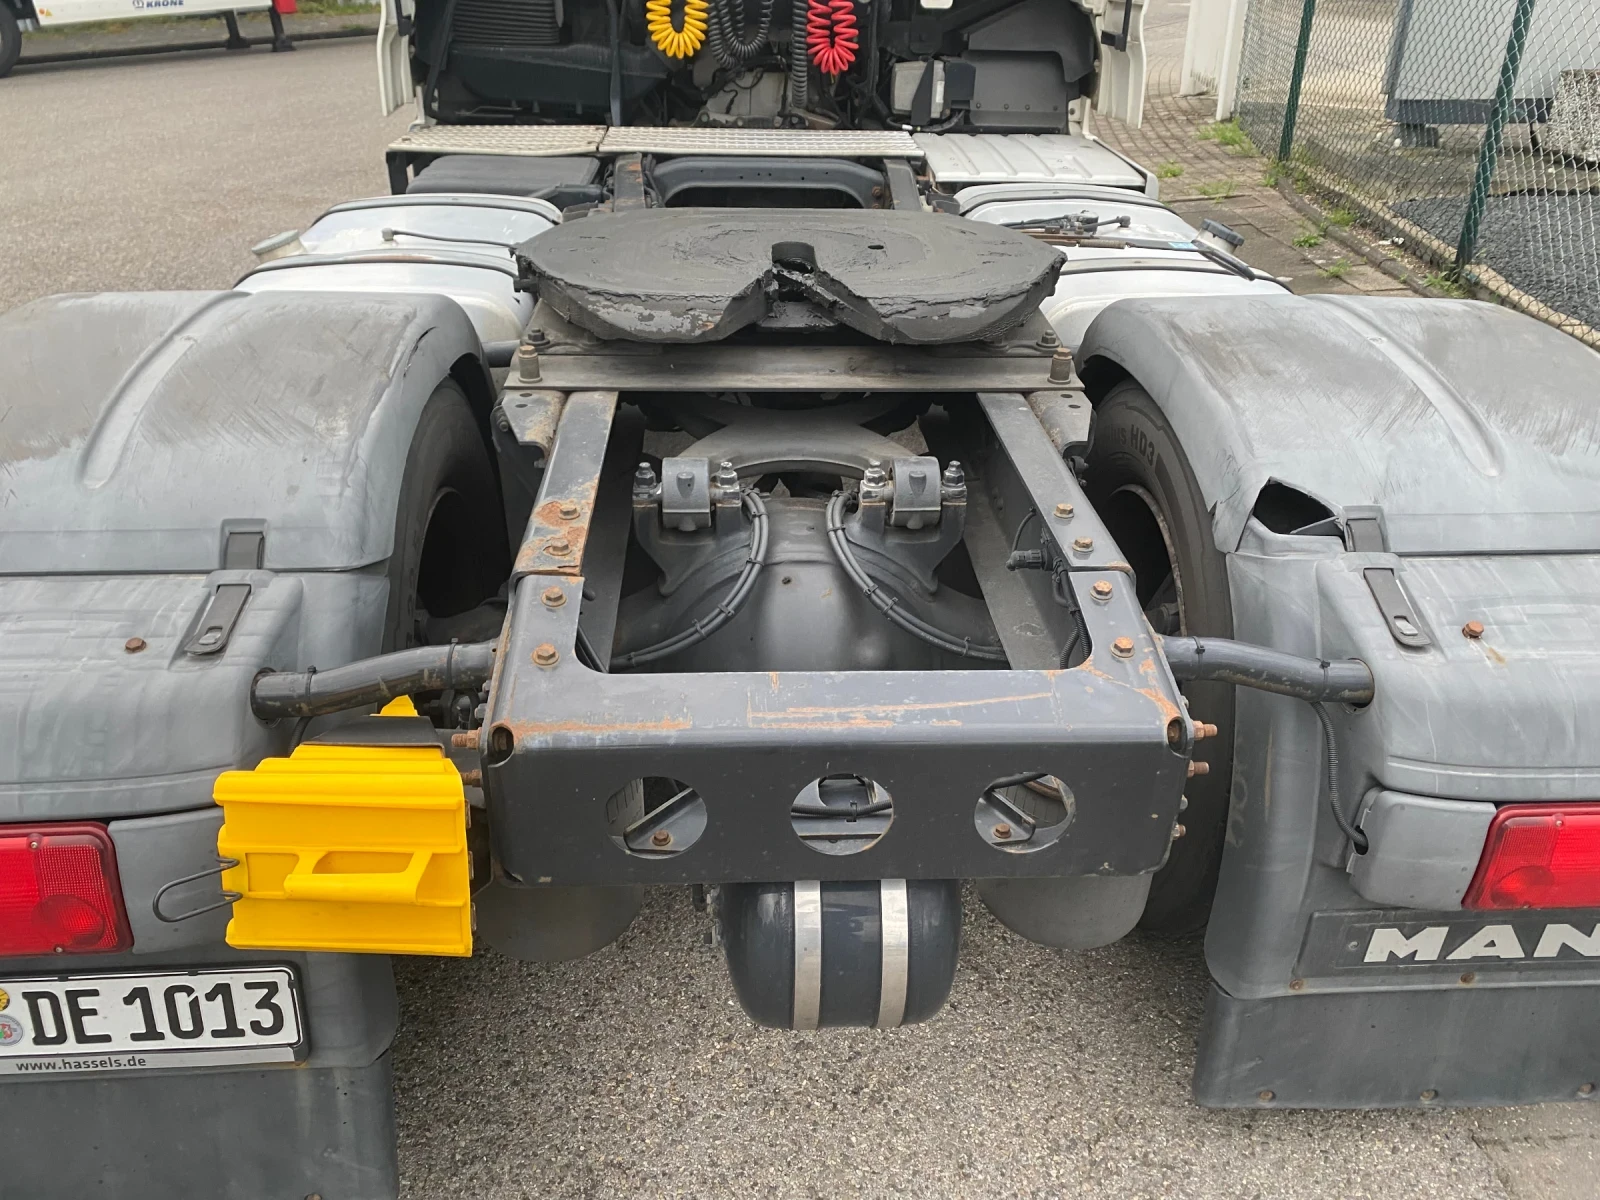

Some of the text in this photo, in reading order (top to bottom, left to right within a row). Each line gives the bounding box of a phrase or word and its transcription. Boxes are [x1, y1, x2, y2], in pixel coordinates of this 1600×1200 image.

[146, 0, 184, 8] KRONE
[1130, 424, 1155, 466] HD3
[1363, 923, 1600, 962] MAN
[22, 981, 284, 1046] DE 1013
[16, 1055, 147, 1071] www.hassels.de
